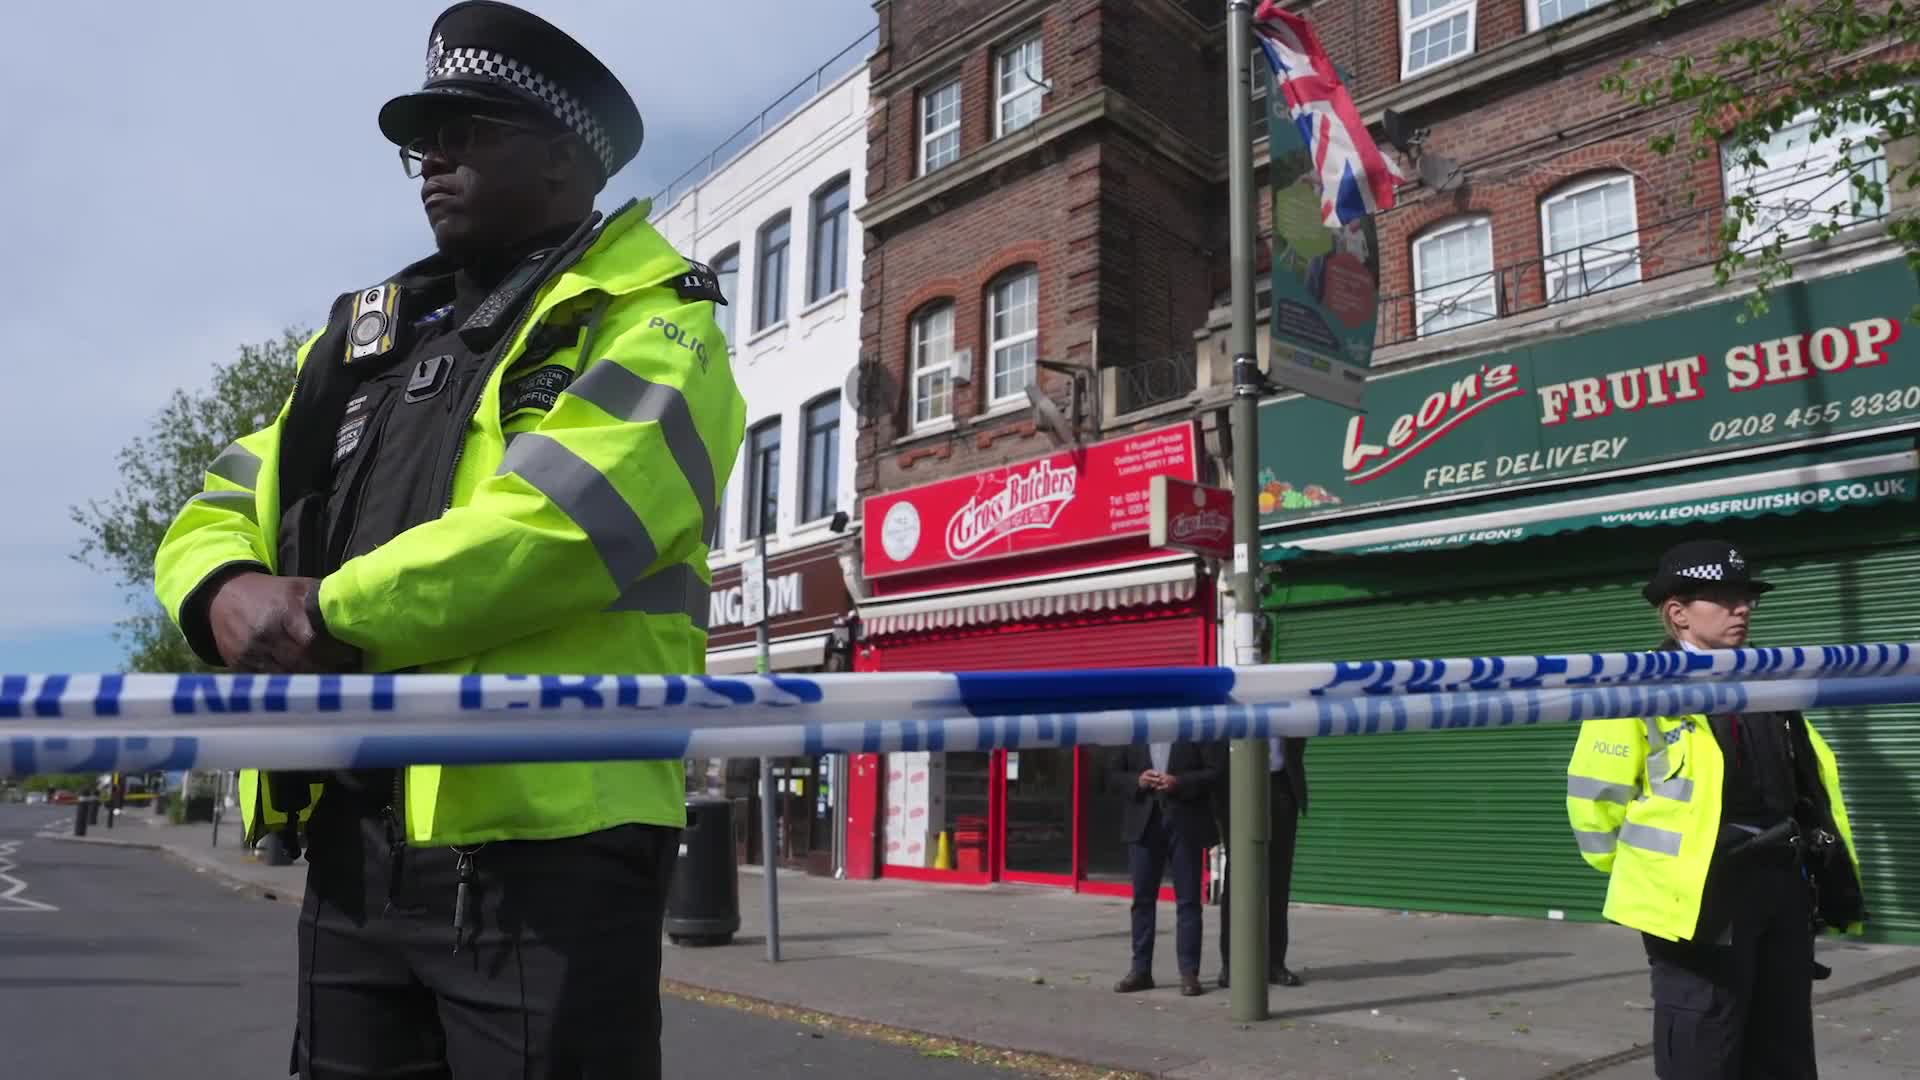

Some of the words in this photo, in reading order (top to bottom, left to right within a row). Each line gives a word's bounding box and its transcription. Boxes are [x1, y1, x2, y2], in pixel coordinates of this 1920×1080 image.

[1537, 353, 1707, 426] FRUIT
[1725, 318, 1901, 391] SHOP
[1709, 413, 1777, 442] 0208
[1784, 401, 1841, 429] 455
[1850, 386, 1920, 418] 3330
[1424, 461, 1488, 489] FREE
[1496, 437, 1629, 477] DELIVERY
[951, 496, 1007, 551] Gross
[1007, 459, 1077, 511] Butchers
[1446, 532, 1466, 544] AT
[1469, 527, 1524, 541] LEON'S
[1592, 740, 1630, 758] POLICE
